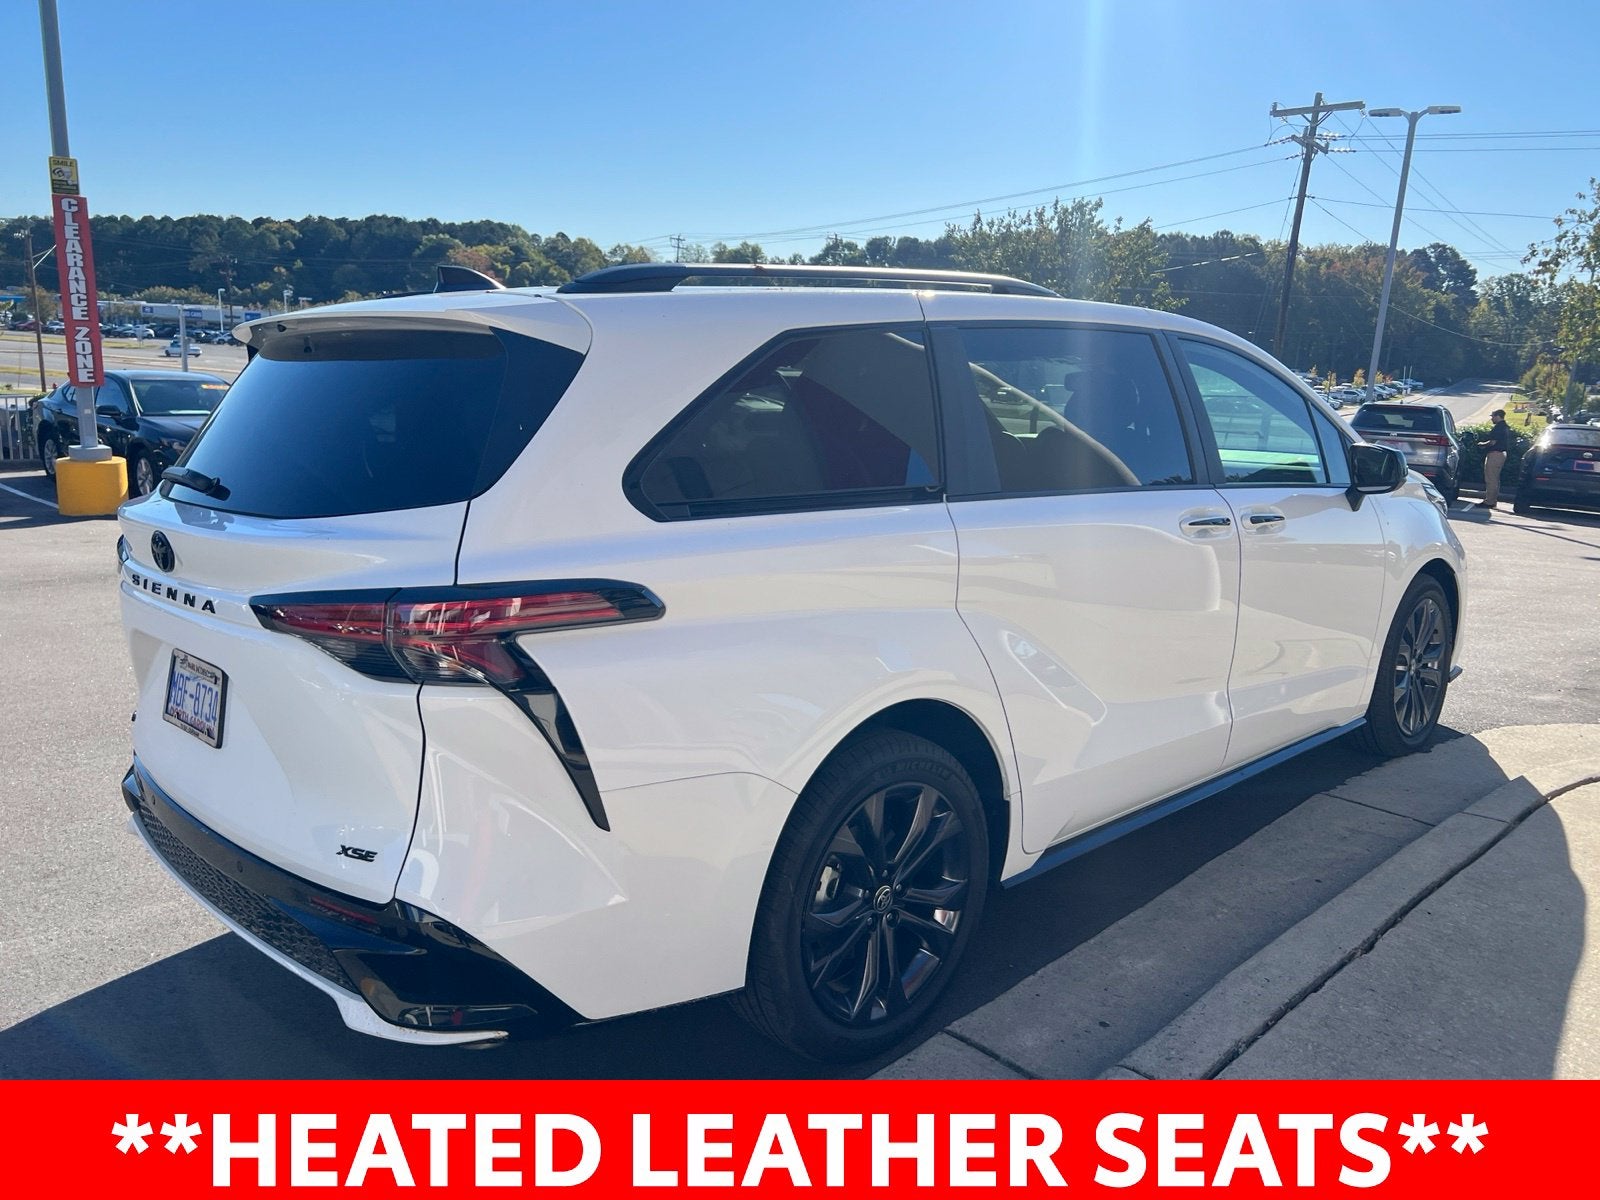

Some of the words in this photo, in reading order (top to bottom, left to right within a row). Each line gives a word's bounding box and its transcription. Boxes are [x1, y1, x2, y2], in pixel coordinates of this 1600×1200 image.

[52, 159, 75, 168] SMILE
[61, 197, 90, 321] CLEARANCE
[74, 326, 95, 383] ZONE
[132, 574, 216, 614] SIENNA
[336, 844, 378, 863] XSE
